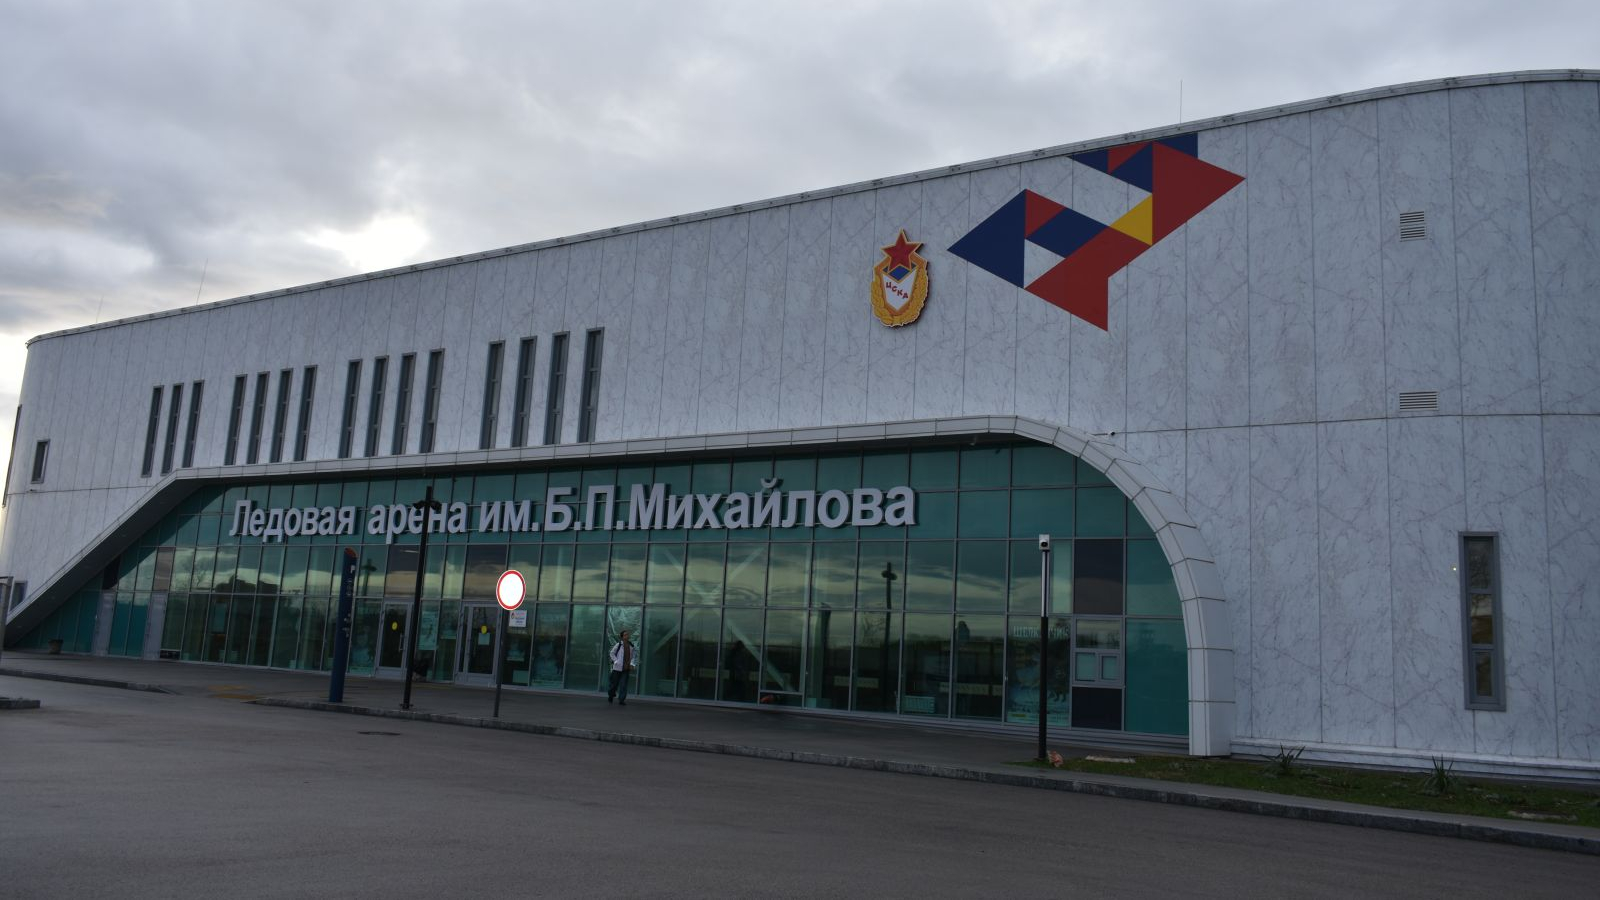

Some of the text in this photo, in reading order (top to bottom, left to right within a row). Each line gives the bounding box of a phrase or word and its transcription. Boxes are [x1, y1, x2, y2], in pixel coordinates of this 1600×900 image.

[886, 281, 908, 299] ЦСКА
[229, 499, 356, 543] Ледовая
[367, 501, 468, 544] арена
